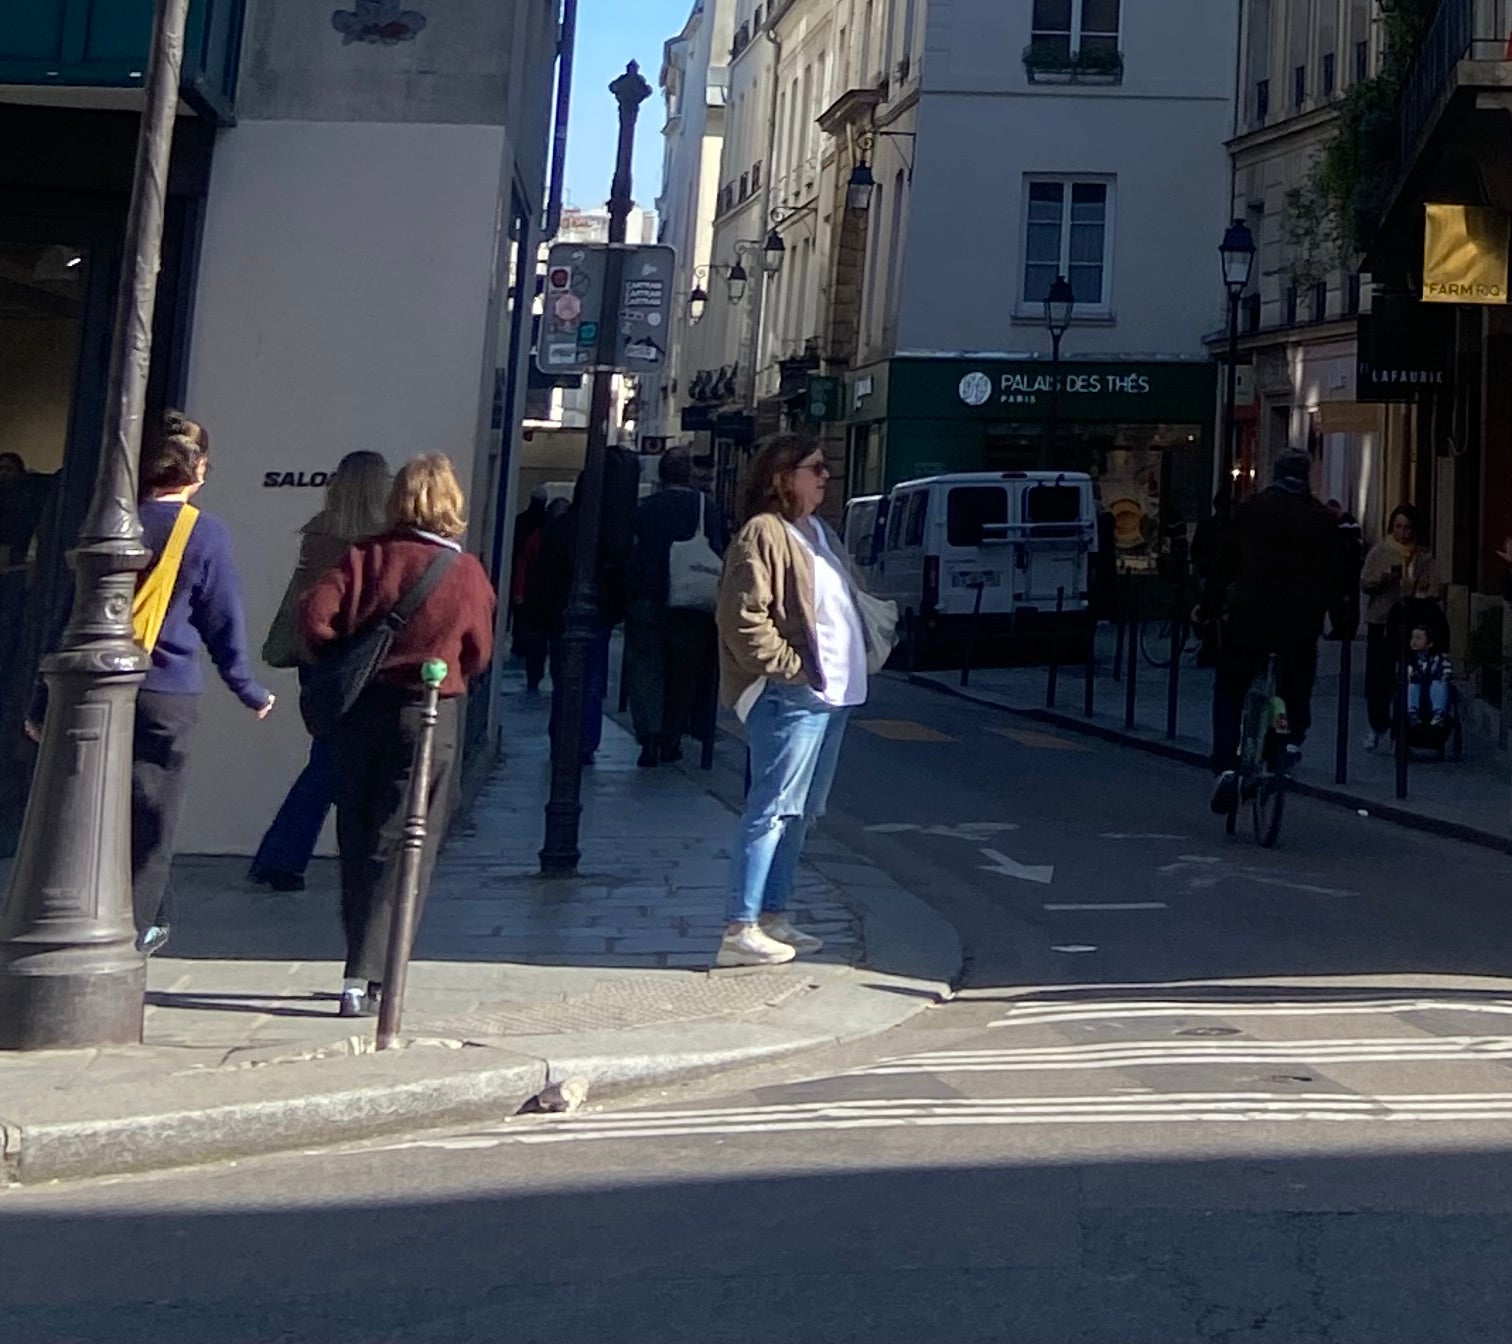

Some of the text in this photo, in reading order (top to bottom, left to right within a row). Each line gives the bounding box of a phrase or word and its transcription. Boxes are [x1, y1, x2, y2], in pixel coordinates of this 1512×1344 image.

[1429, 282, 1473, 297] FARM
[1066, 375, 1101, 393] DES
[1106, 372, 1150, 393] THÉS
[1371, 369, 1443, 384] LAFAURIE
[1001, 395, 1037, 405] PARIS
[263, 471, 336, 488] SALO
